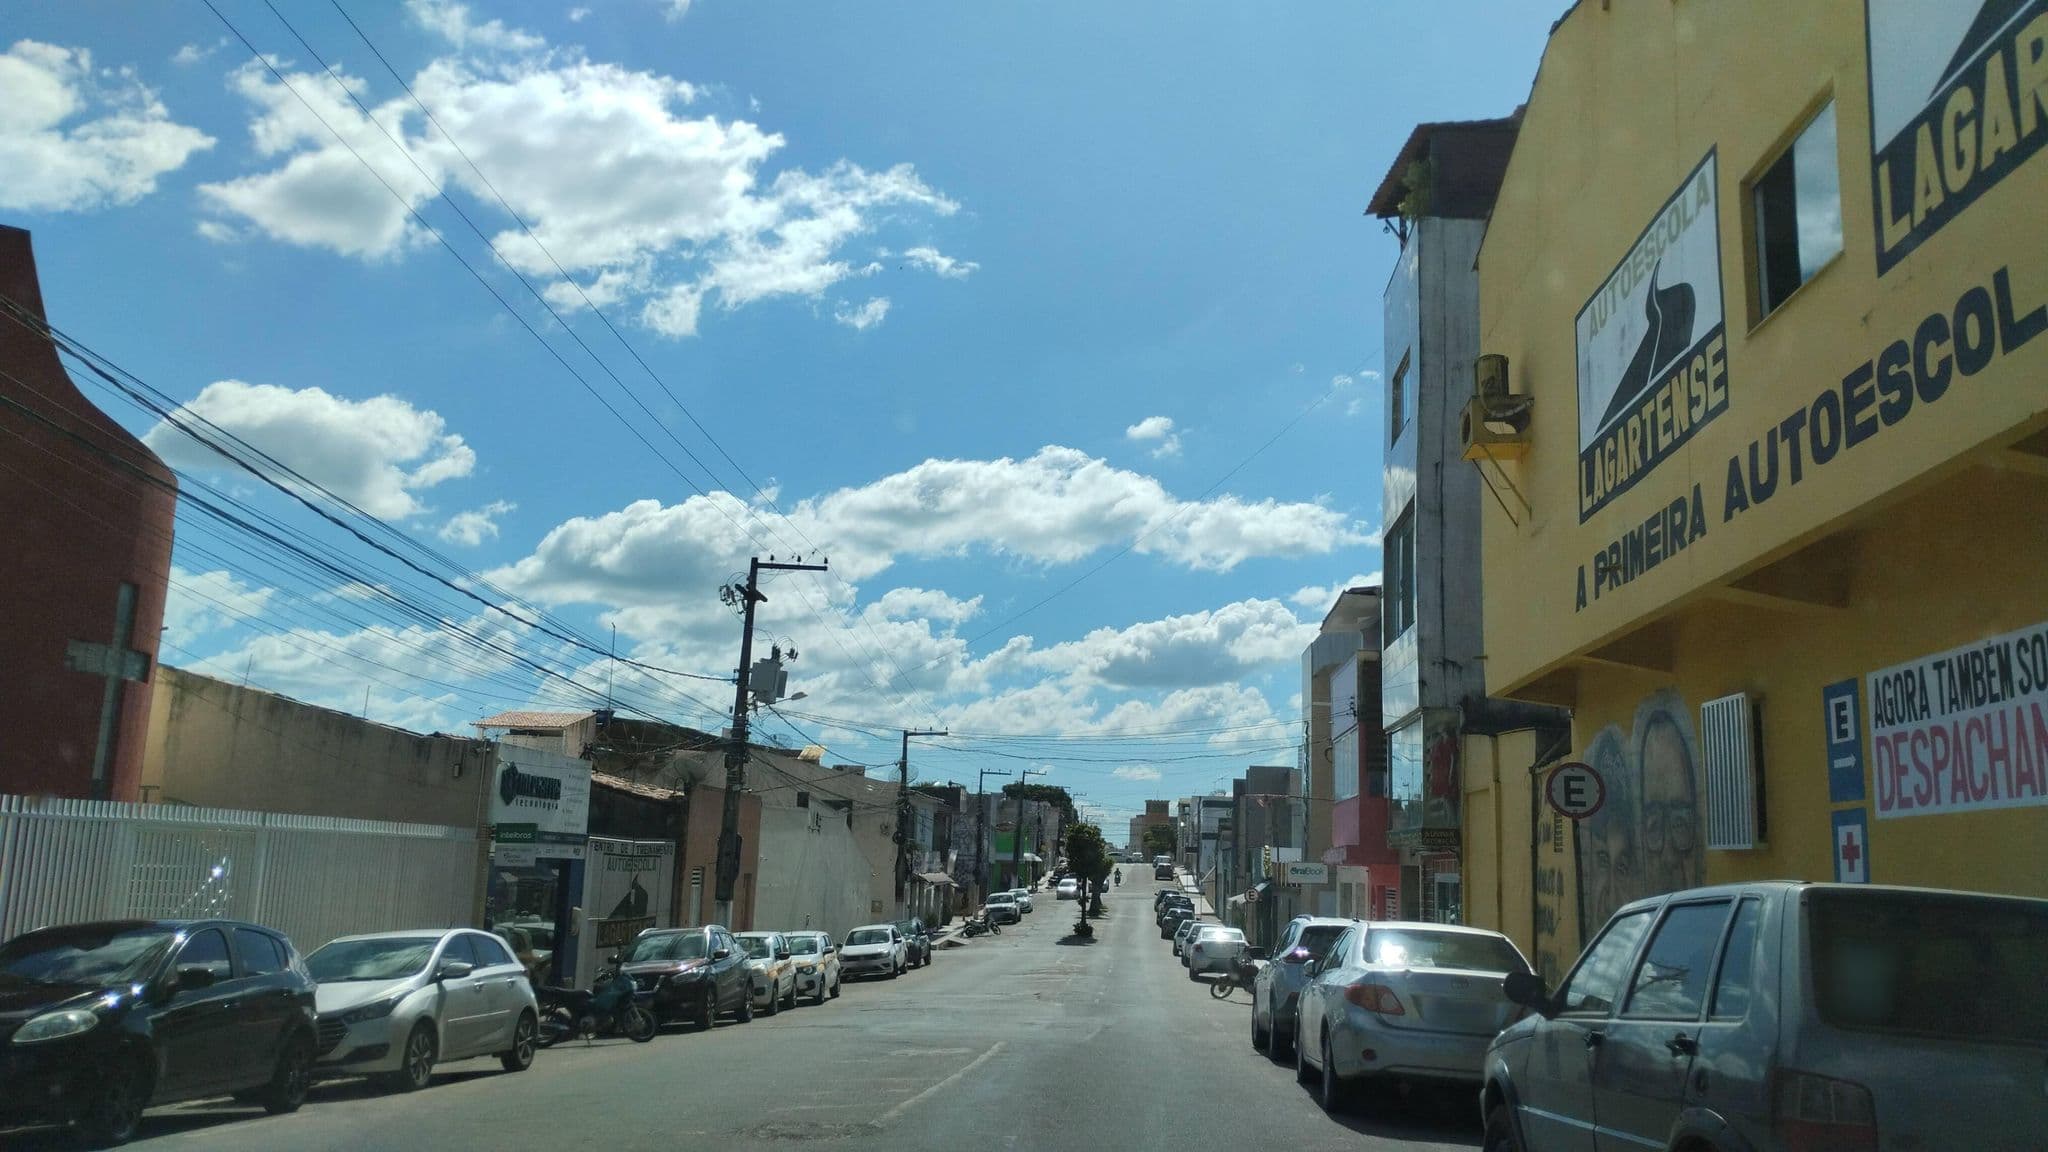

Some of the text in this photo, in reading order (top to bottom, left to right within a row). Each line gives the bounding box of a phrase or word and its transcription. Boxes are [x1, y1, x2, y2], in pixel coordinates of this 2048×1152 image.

[1588, 170, 1711, 339] AUTOESCOLA
[1576, 265, 2048, 613] A PRIMEIRA AUTOESCOL
[1581, 335, 1726, 519] LAGARTENSE
[1834, 703, 1849, 739] E
[1874, 665, 1931, 729] AGORA
[1933, 640, 2015, 716] TAMBÉM
[1564, 775, 1586, 806] E
